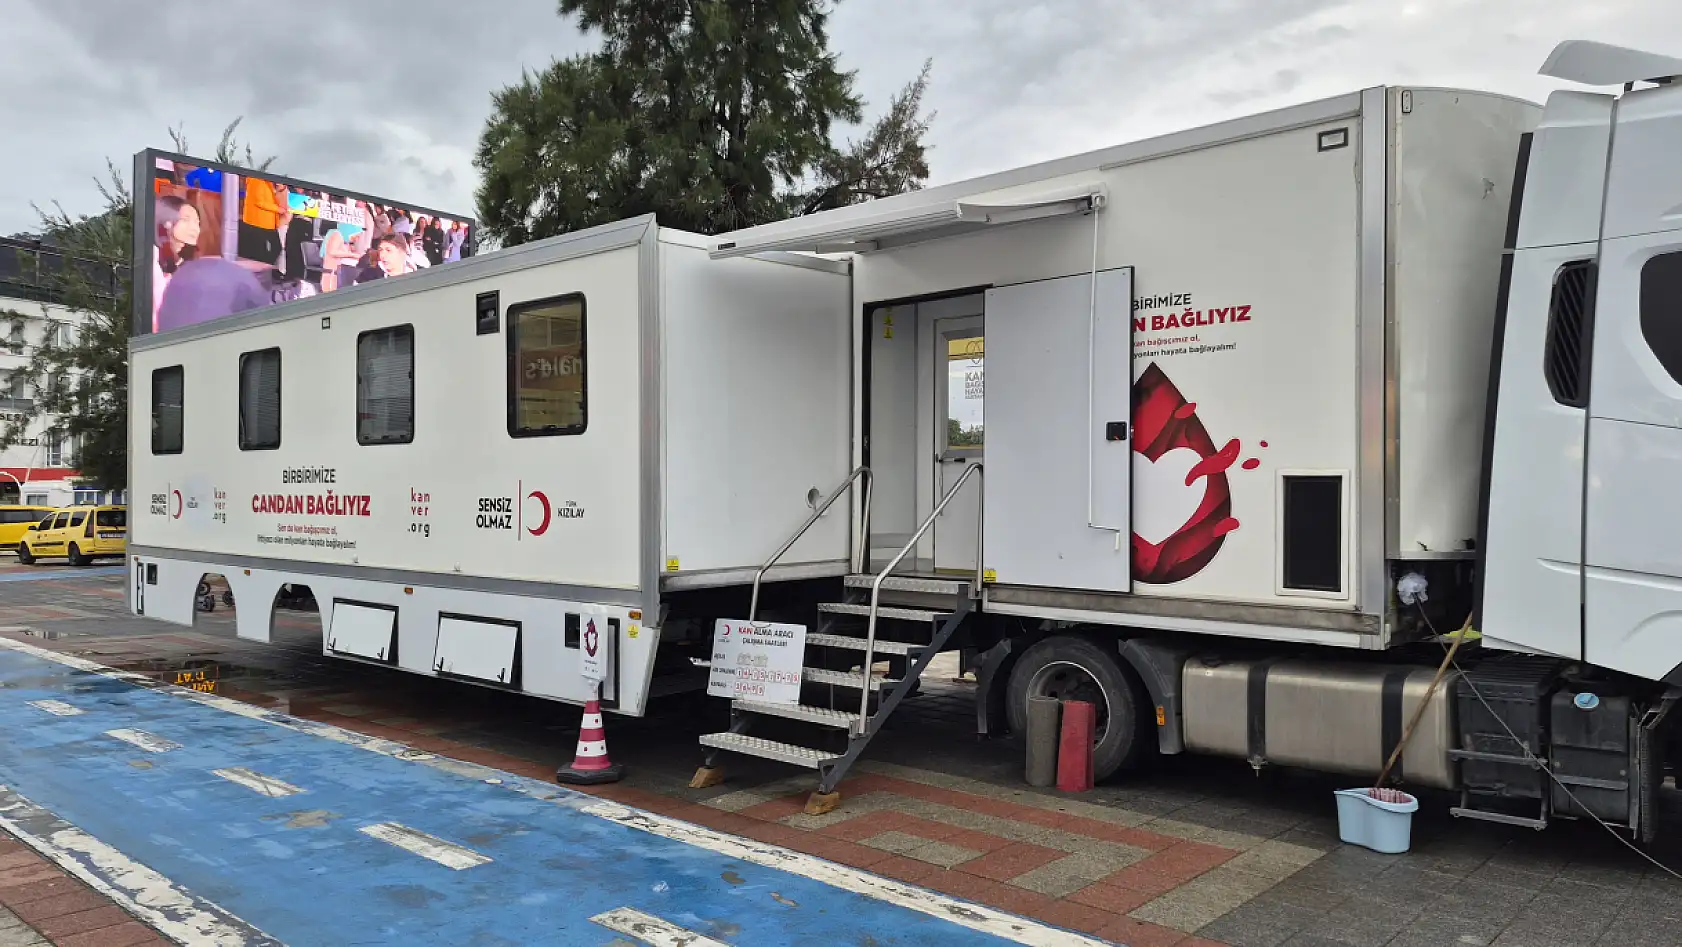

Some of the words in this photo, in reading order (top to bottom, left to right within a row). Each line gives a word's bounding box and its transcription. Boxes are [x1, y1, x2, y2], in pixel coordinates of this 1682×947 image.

[1152, 305, 1252, 331] BAĞLIYIZ
[283, 465, 336, 483] BİRBİRİMİZE
[411, 487, 430, 502] kan
[252, 495, 304, 515] CANDAN
[306, 489, 371, 516] BAĞLIYIZ
[478, 496, 512, 513] SENSİZ
[411, 506, 429, 516] ver
[557, 507, 585, 518] KIZILAY
[407, 522, 430, 537] .org
[476, 515, 512, 529] OLMAZ
[754, 629, 773, 637] ALMA
